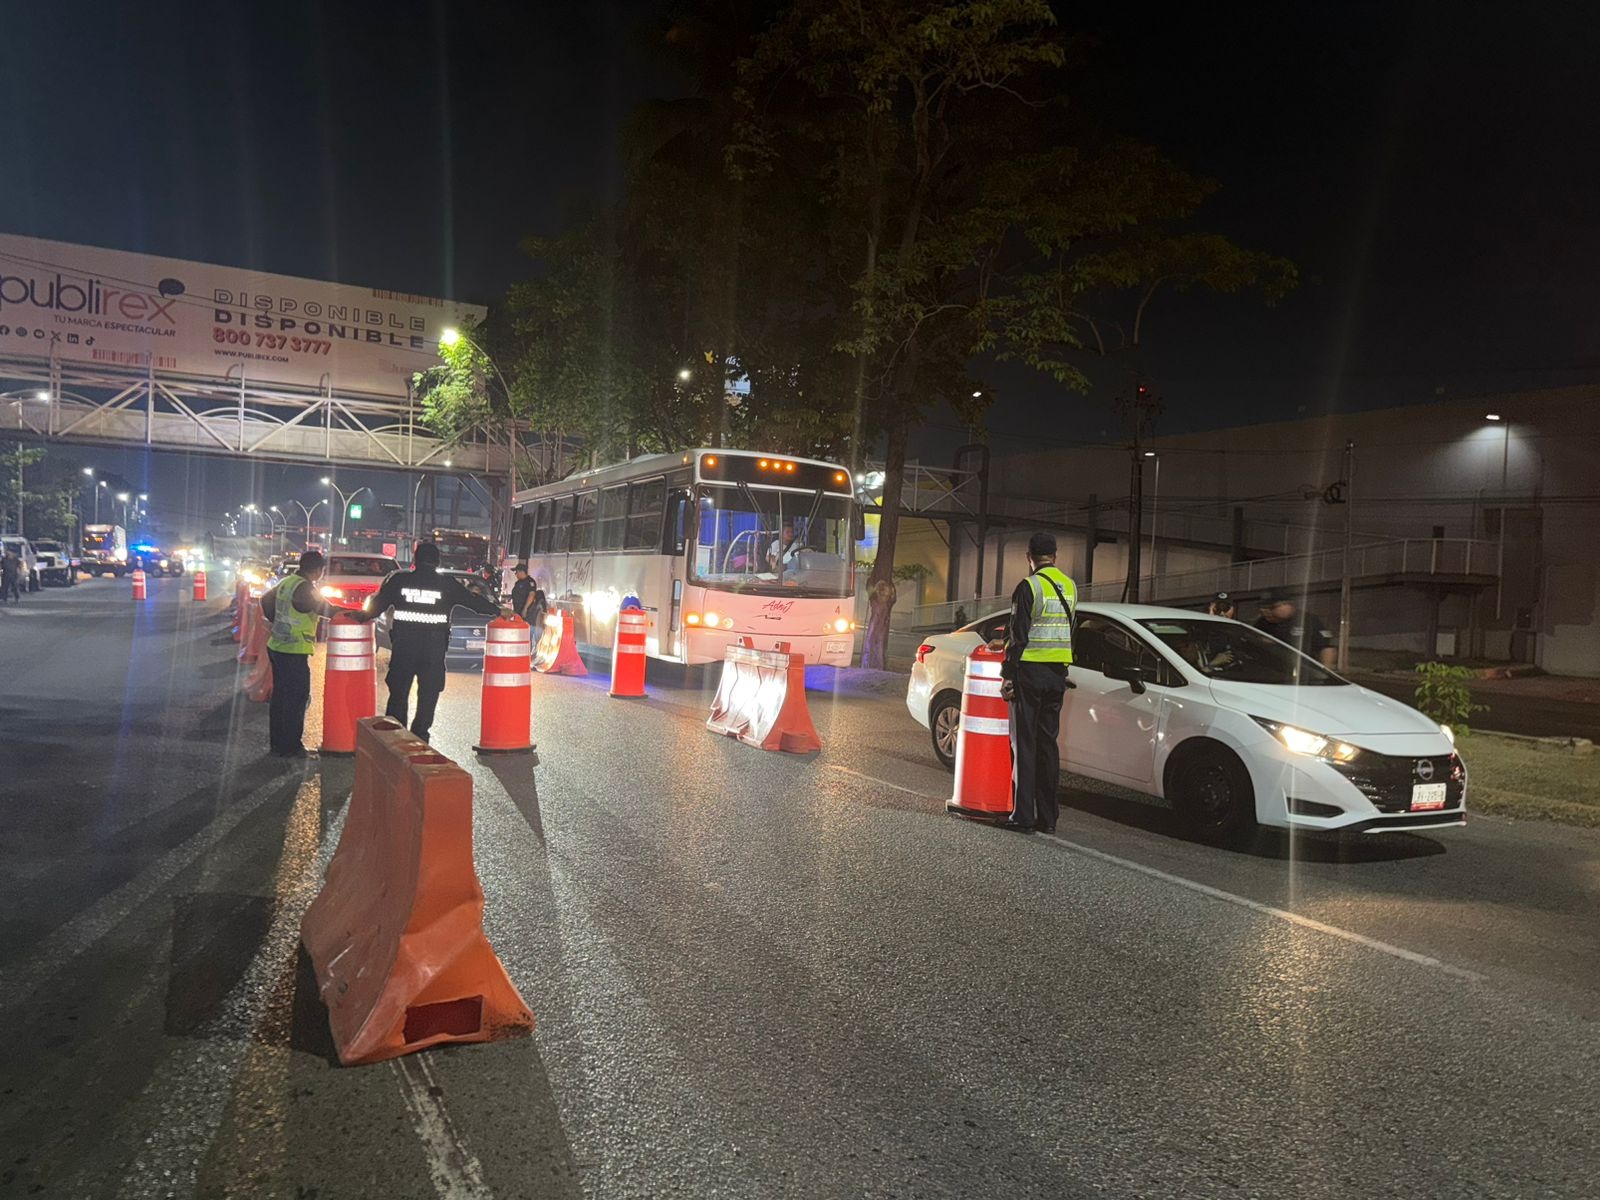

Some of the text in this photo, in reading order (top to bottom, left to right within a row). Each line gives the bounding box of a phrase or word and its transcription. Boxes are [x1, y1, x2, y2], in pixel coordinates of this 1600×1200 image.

[54, 314, 176, 337] TU MARCA ESPECTACULAR
[214, 288, 425, 332] DISPONIBLE
[213, 327, 331, 356] 800 737 3777
[215, 308, 424, 349] DISPONIBLE
